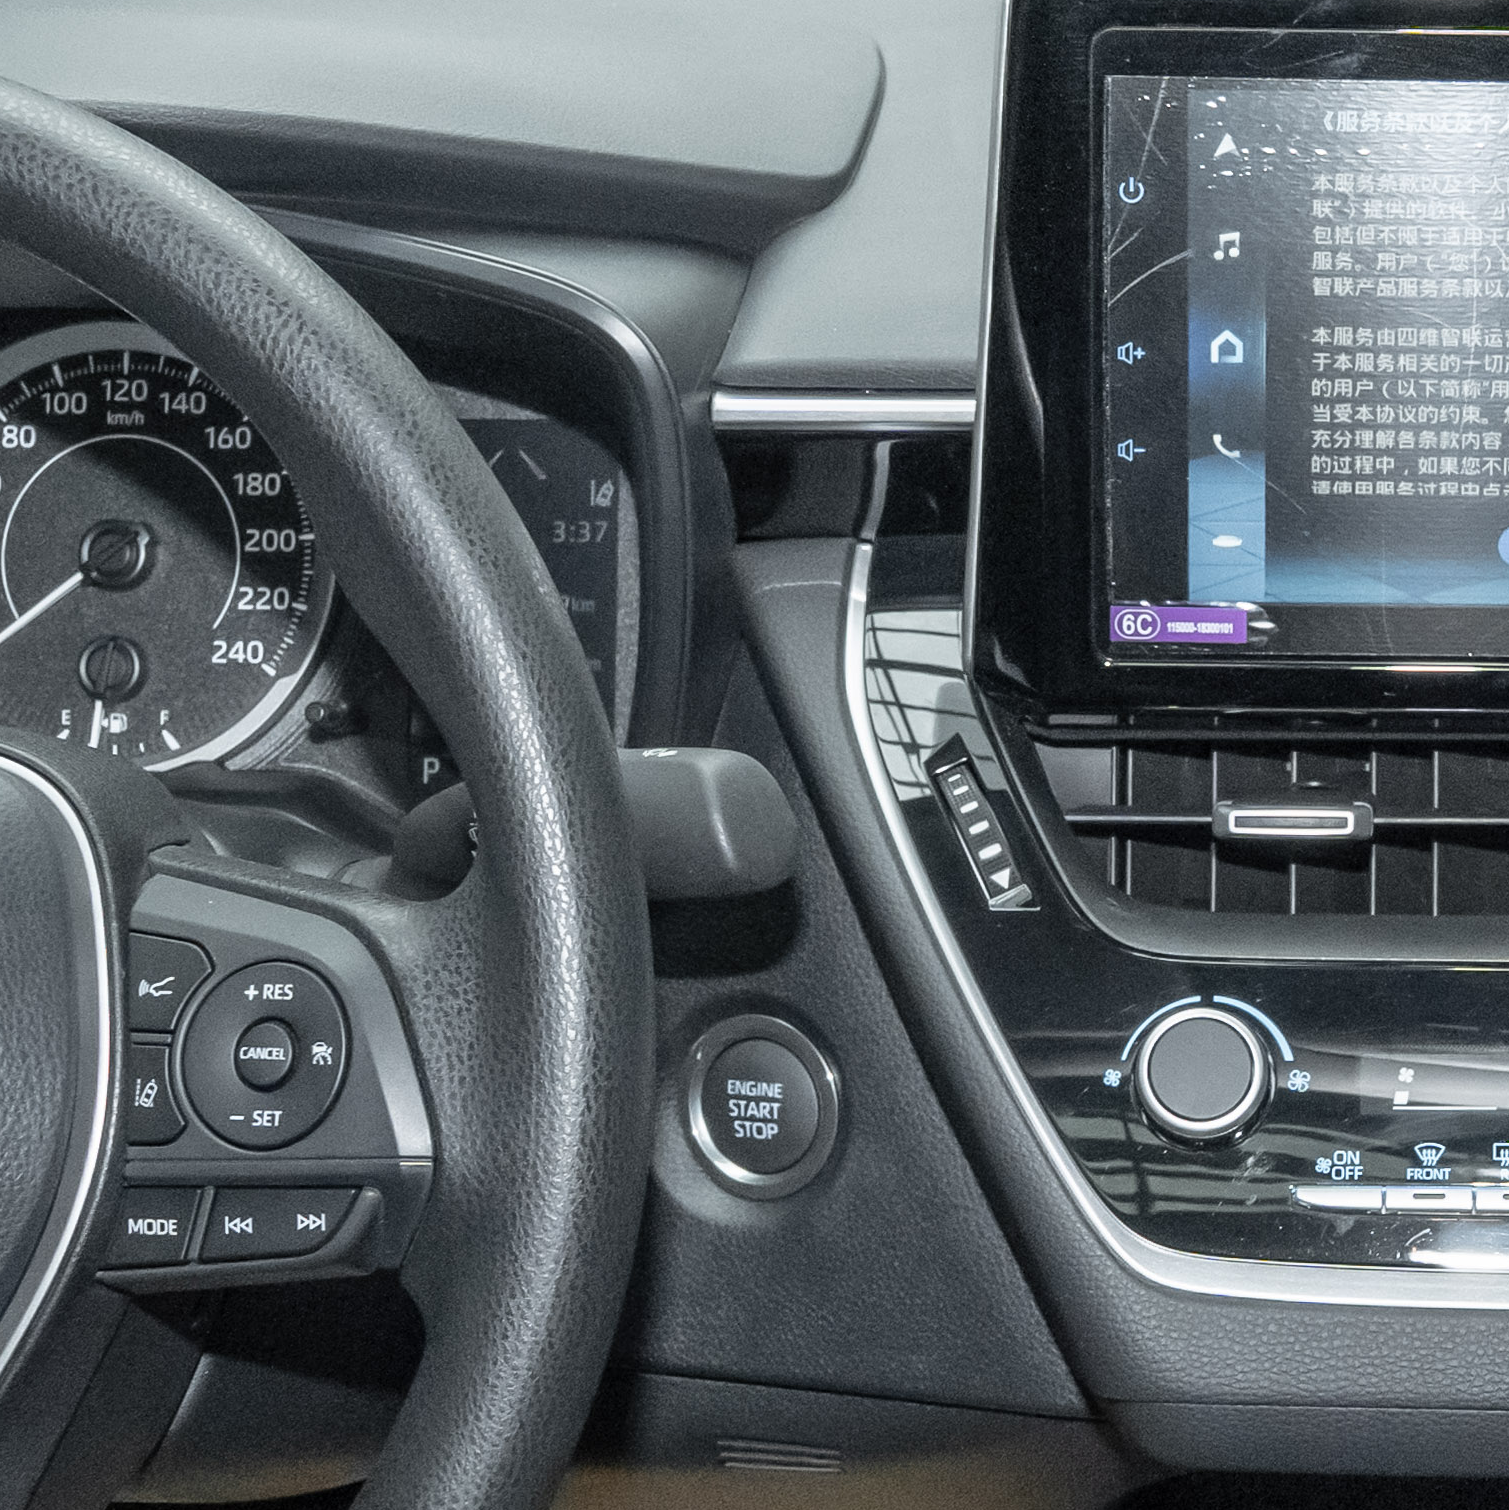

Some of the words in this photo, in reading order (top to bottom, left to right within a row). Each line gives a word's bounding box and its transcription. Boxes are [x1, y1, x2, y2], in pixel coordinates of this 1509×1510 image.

[101, 379, 148, 402] 120
[41, 392, 87, 415] 100
[160, 392, 206, 415] 140
[107, 410, 145, 426] km/h
[1, 425, 37, 449] 80
[204, 426, 252, 449] 160
[233, 473, 281, 497] 180
[244, 528, 296, 552] 200
[552, 520, 609, 544] 3:37
[237, 586, 290, 611] 220
[1121, 613, 1153, 636] 6C
[211, 640, 264, 665] 240
[61, 709, 71, 726] E
[159, 709, 170, 726] F
[422, 757, 441, 785] P
[239, 1045, 286, 1063] CANCEL
[726, 1079, 784, 1100] ENGINE
[728, 1099, 782, 1121] START
[733, 1120, 780, 1141] STOP
[1332, 1149, 1361, 1166] ON
[1330, 1165, 1365, 1182] OFF
[1405, 1167, 1452, 1182] FRONT
[127, 1217, 179, 1237] MODE
